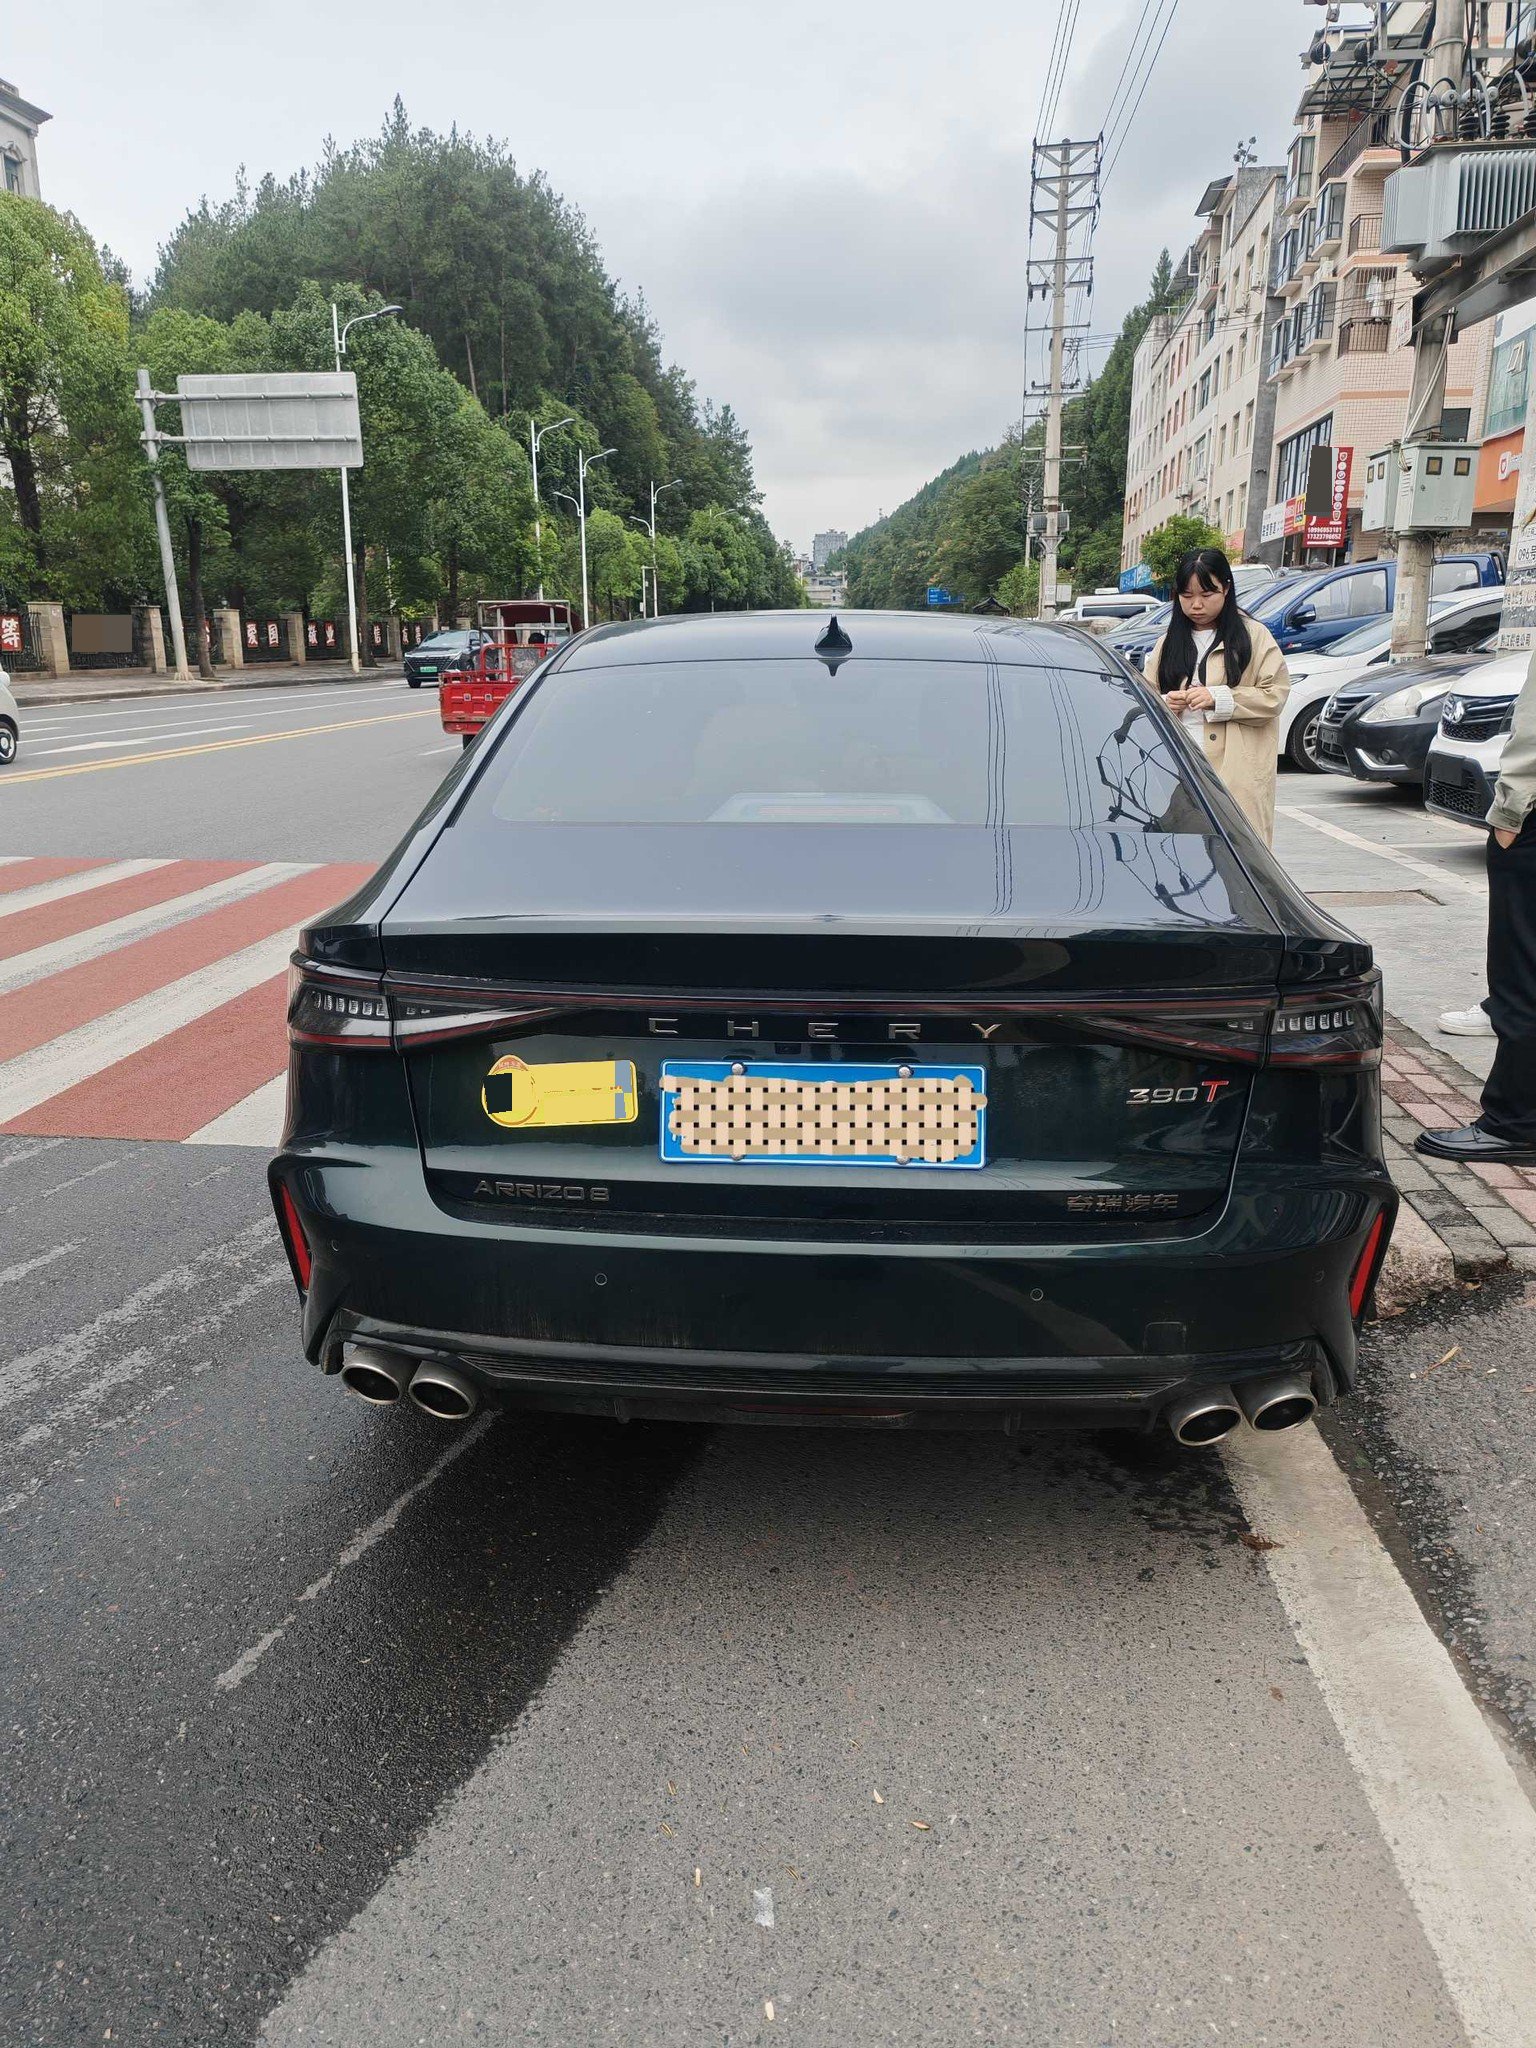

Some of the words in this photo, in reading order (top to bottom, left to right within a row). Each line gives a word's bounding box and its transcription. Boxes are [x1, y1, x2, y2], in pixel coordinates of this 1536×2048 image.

[648, 1017, 1003, 1040] CHERY
[1126, 1079, 1230, 1105] 390T
[1067, 1193, 1179, 1213] 奇瑞汽车
